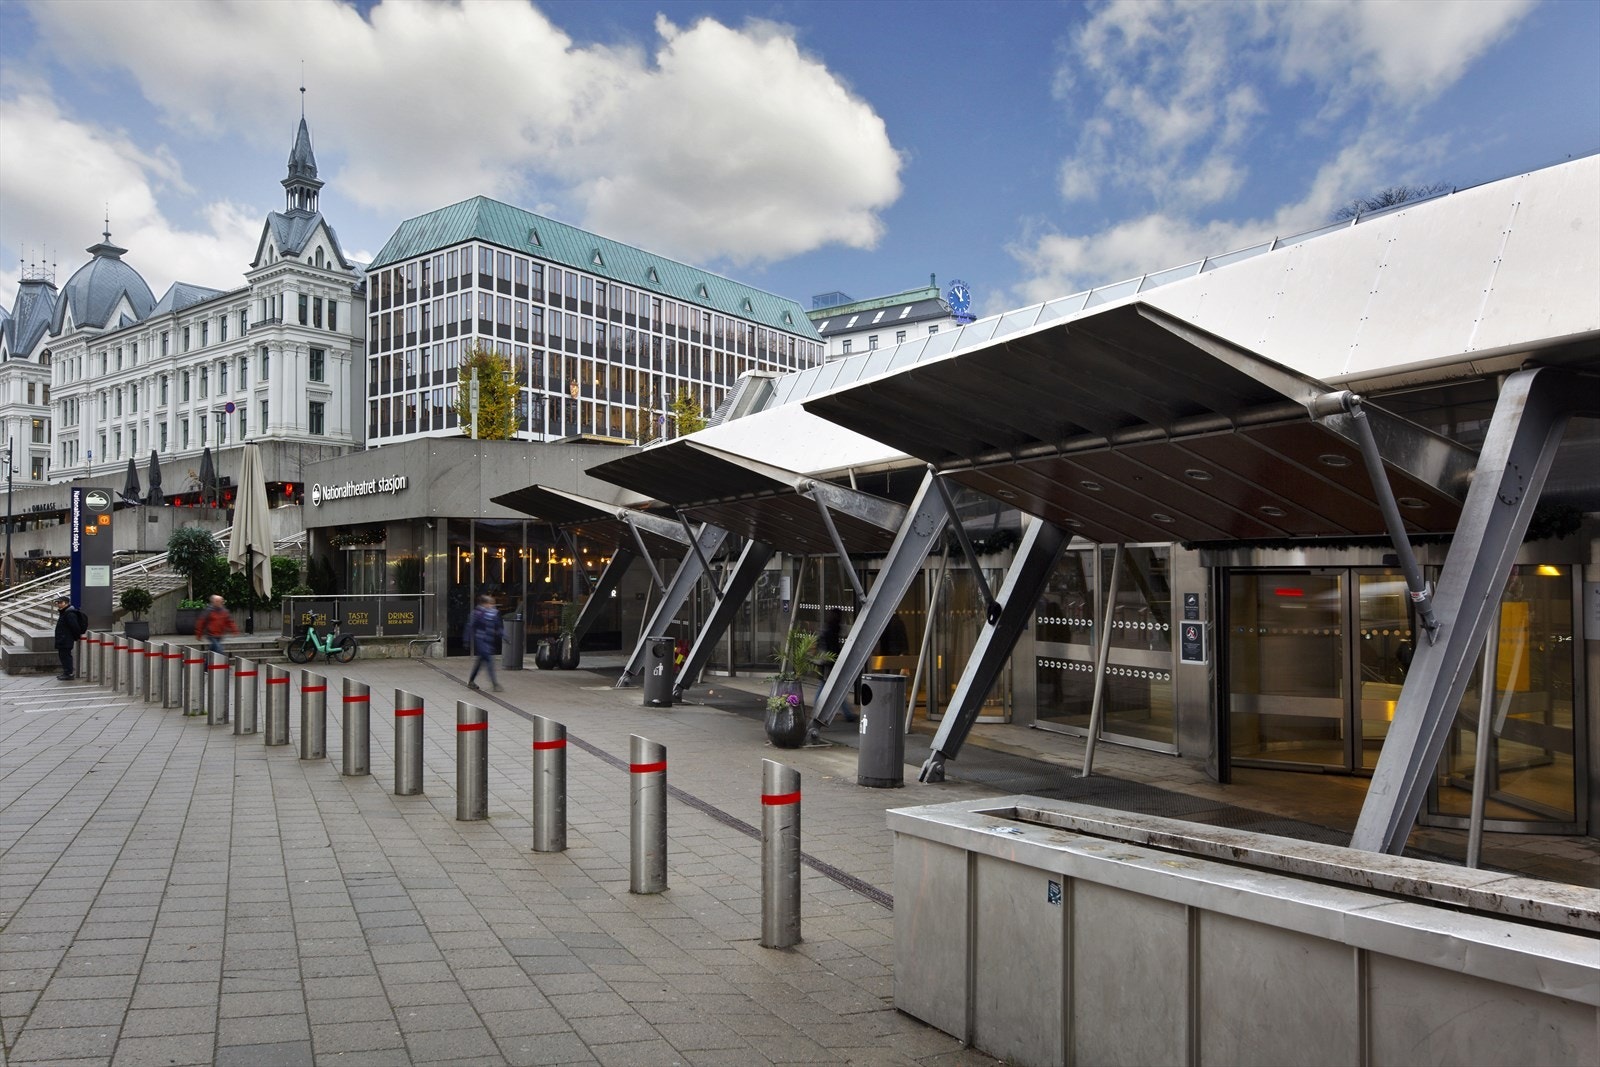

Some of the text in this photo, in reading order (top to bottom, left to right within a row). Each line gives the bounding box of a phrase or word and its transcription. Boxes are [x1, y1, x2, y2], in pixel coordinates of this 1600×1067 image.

[322, 474, 406, 500] Nationaltheatret stasjon
[72, 533, 80, 552] stasjon
[302, 613, 327, 621] FRSH
[387, 611, 414, 620] DRINKS
